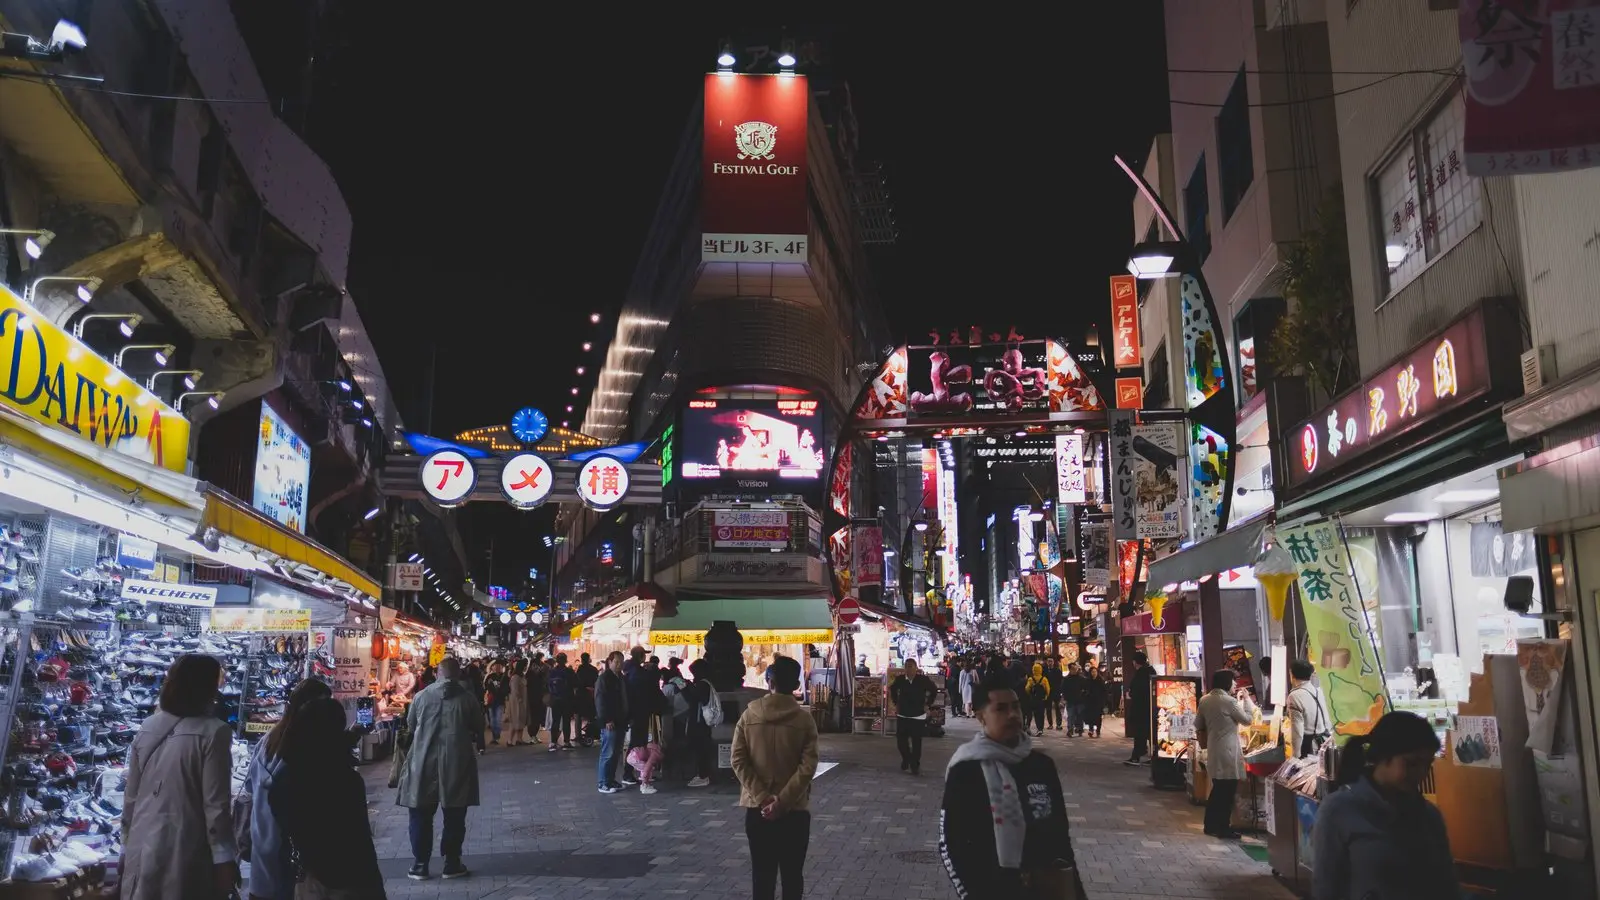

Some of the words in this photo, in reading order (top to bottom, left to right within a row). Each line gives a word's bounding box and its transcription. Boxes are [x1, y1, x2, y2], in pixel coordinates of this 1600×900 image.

[713, 162, 765, 175] FESTIVAL
[766, 163, 799, 175] GOLF
[1487, 148, 1600, 171] うえの桜ま
[0, 308, 137, 450] DAIWA
[433, 459, 620, 496] アメ横
[126, 584, 213, 602] SKECHERS
